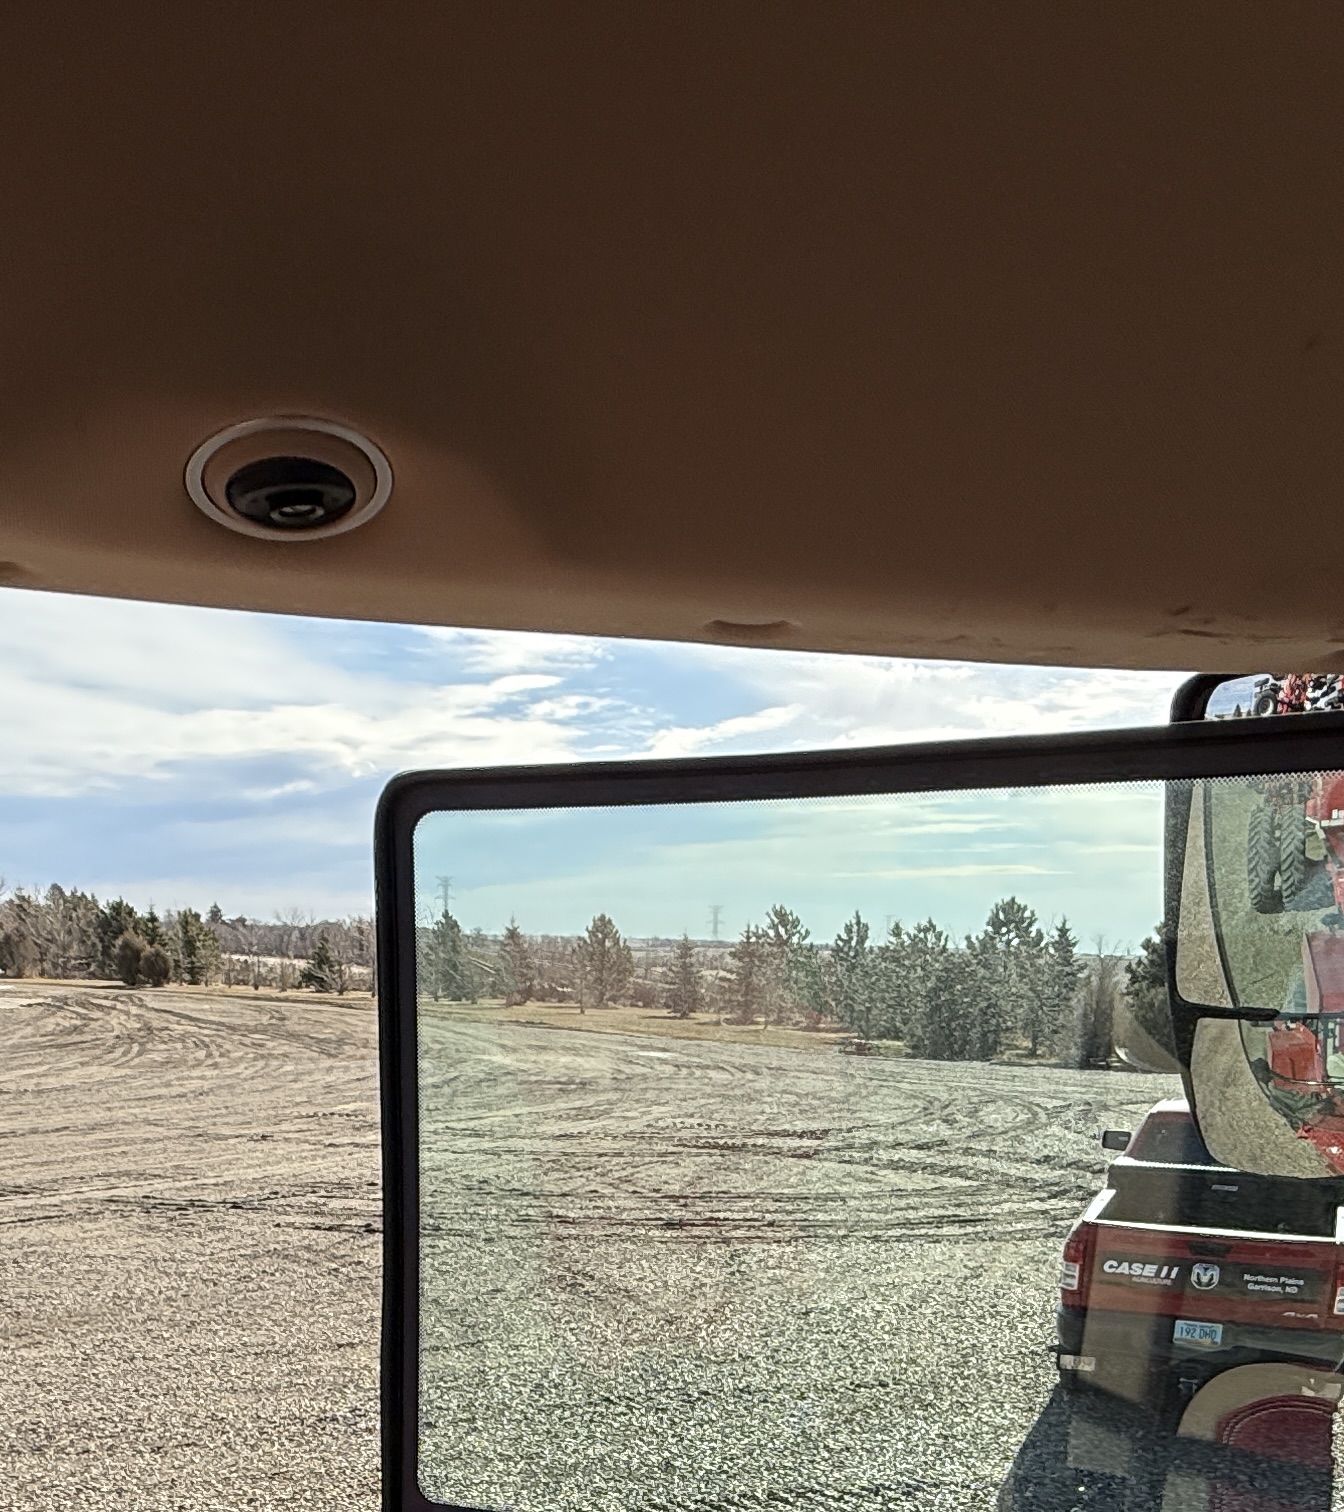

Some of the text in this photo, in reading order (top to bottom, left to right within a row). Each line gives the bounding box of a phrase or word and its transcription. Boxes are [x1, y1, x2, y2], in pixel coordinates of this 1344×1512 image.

[1103, 1260, 1159, 1277] CASE
[1243, 1273, 1278, 1283] Northern
[1180, 1327, 1197, 1339] 192
